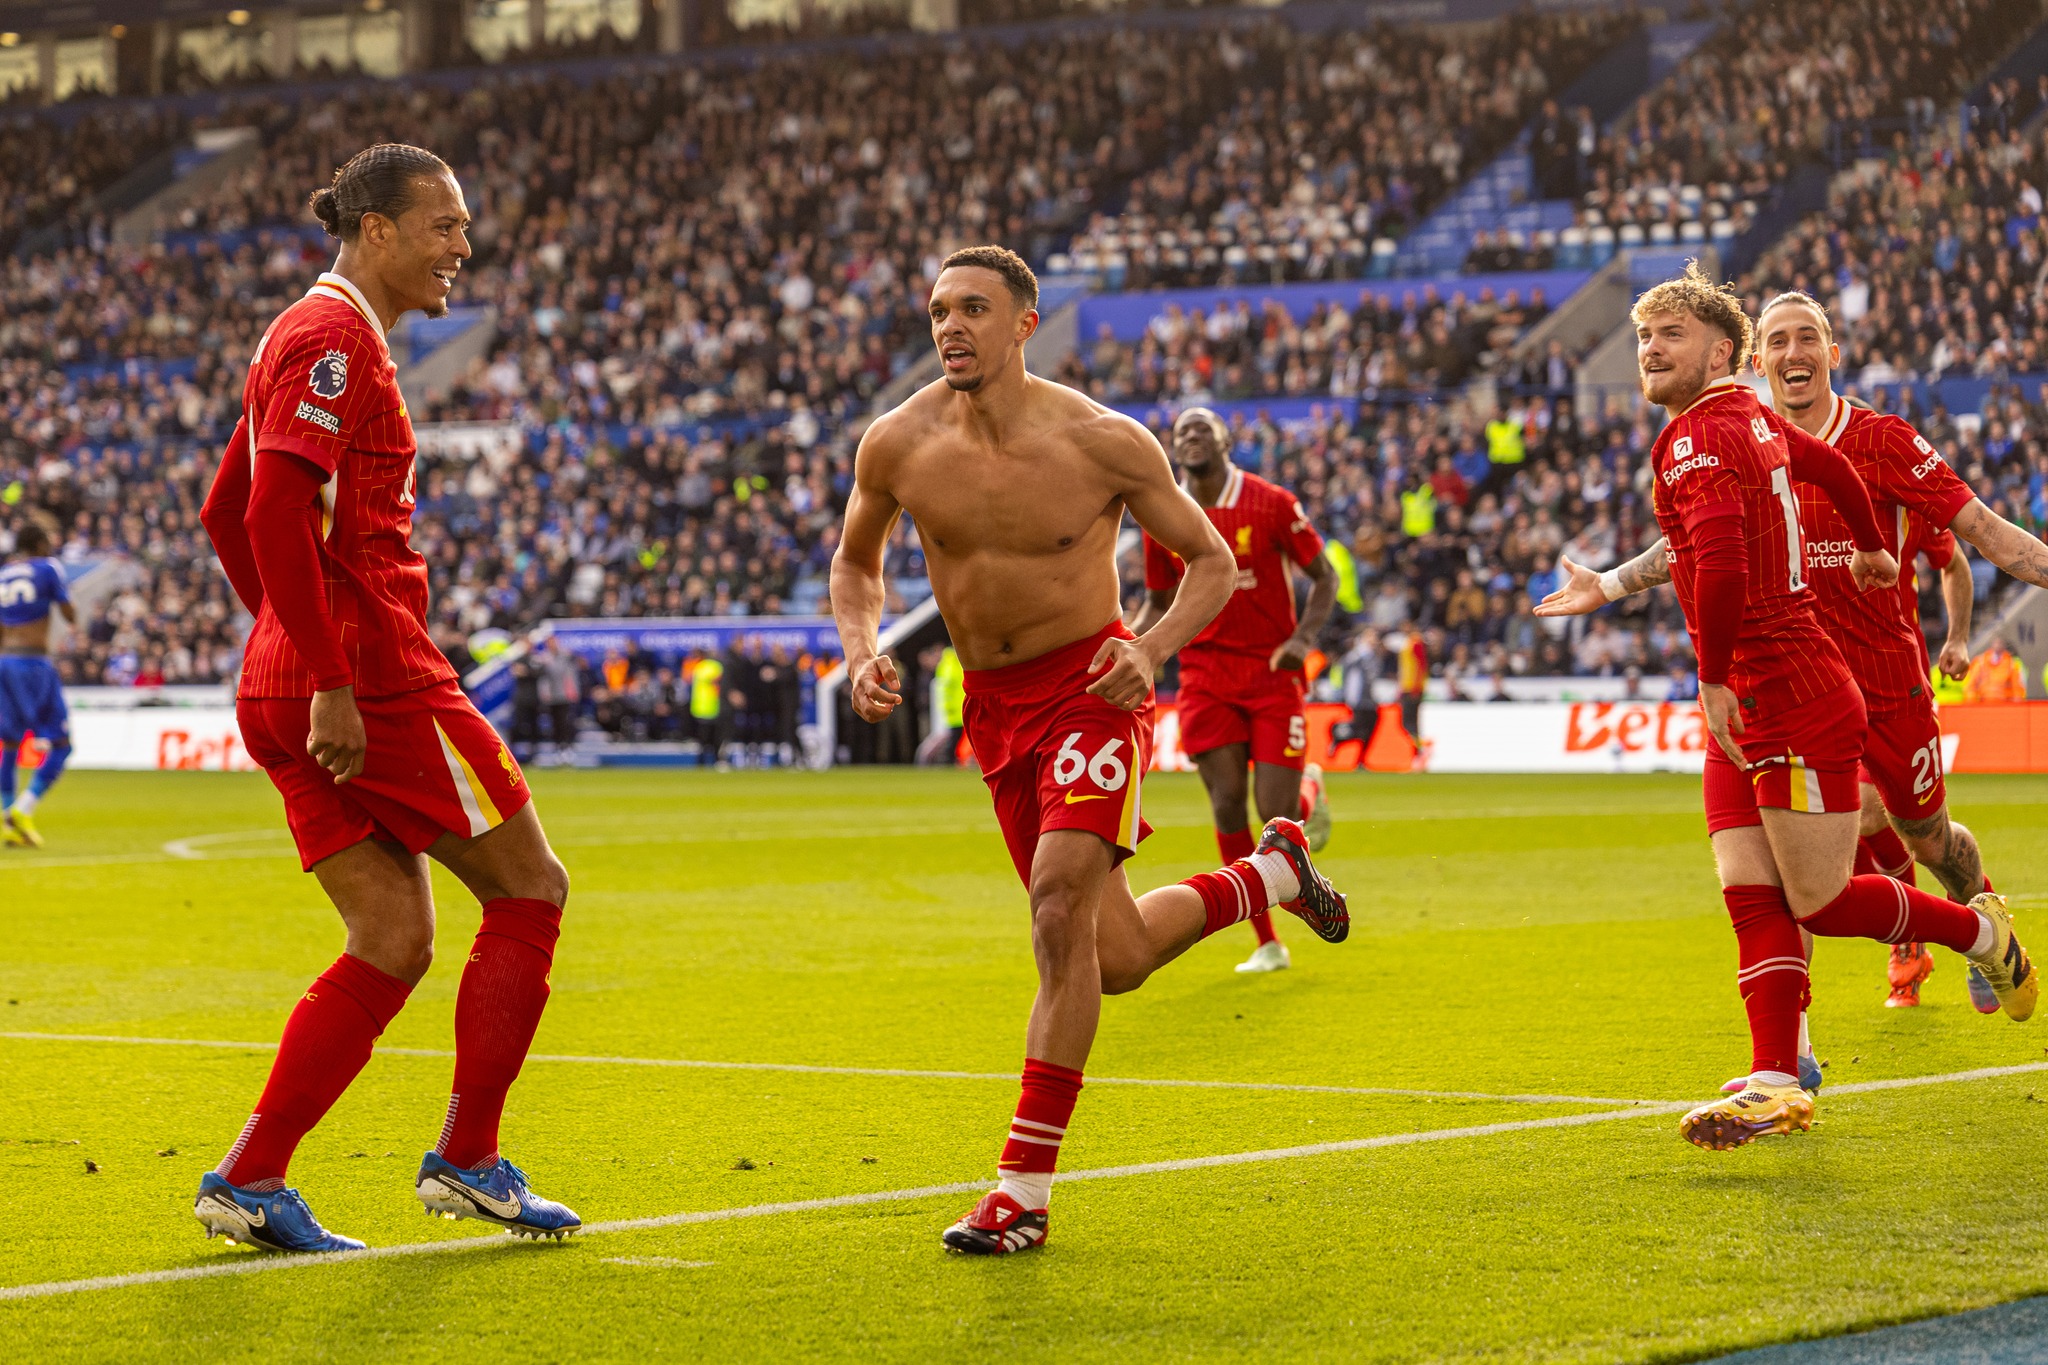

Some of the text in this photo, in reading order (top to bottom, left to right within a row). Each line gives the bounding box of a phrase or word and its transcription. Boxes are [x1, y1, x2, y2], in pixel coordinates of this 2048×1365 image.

[299, 401, 340, 426] No room
[309, 414, 340, 435] racism
[1662, 453, 1720, 487] Expedia
[1770, 465, 1809, 593] 1
[1288, 715, 1306, 750] 5
[1053, 732, 1127, 792] 66
[1911, 735, 1941, 795] 21
